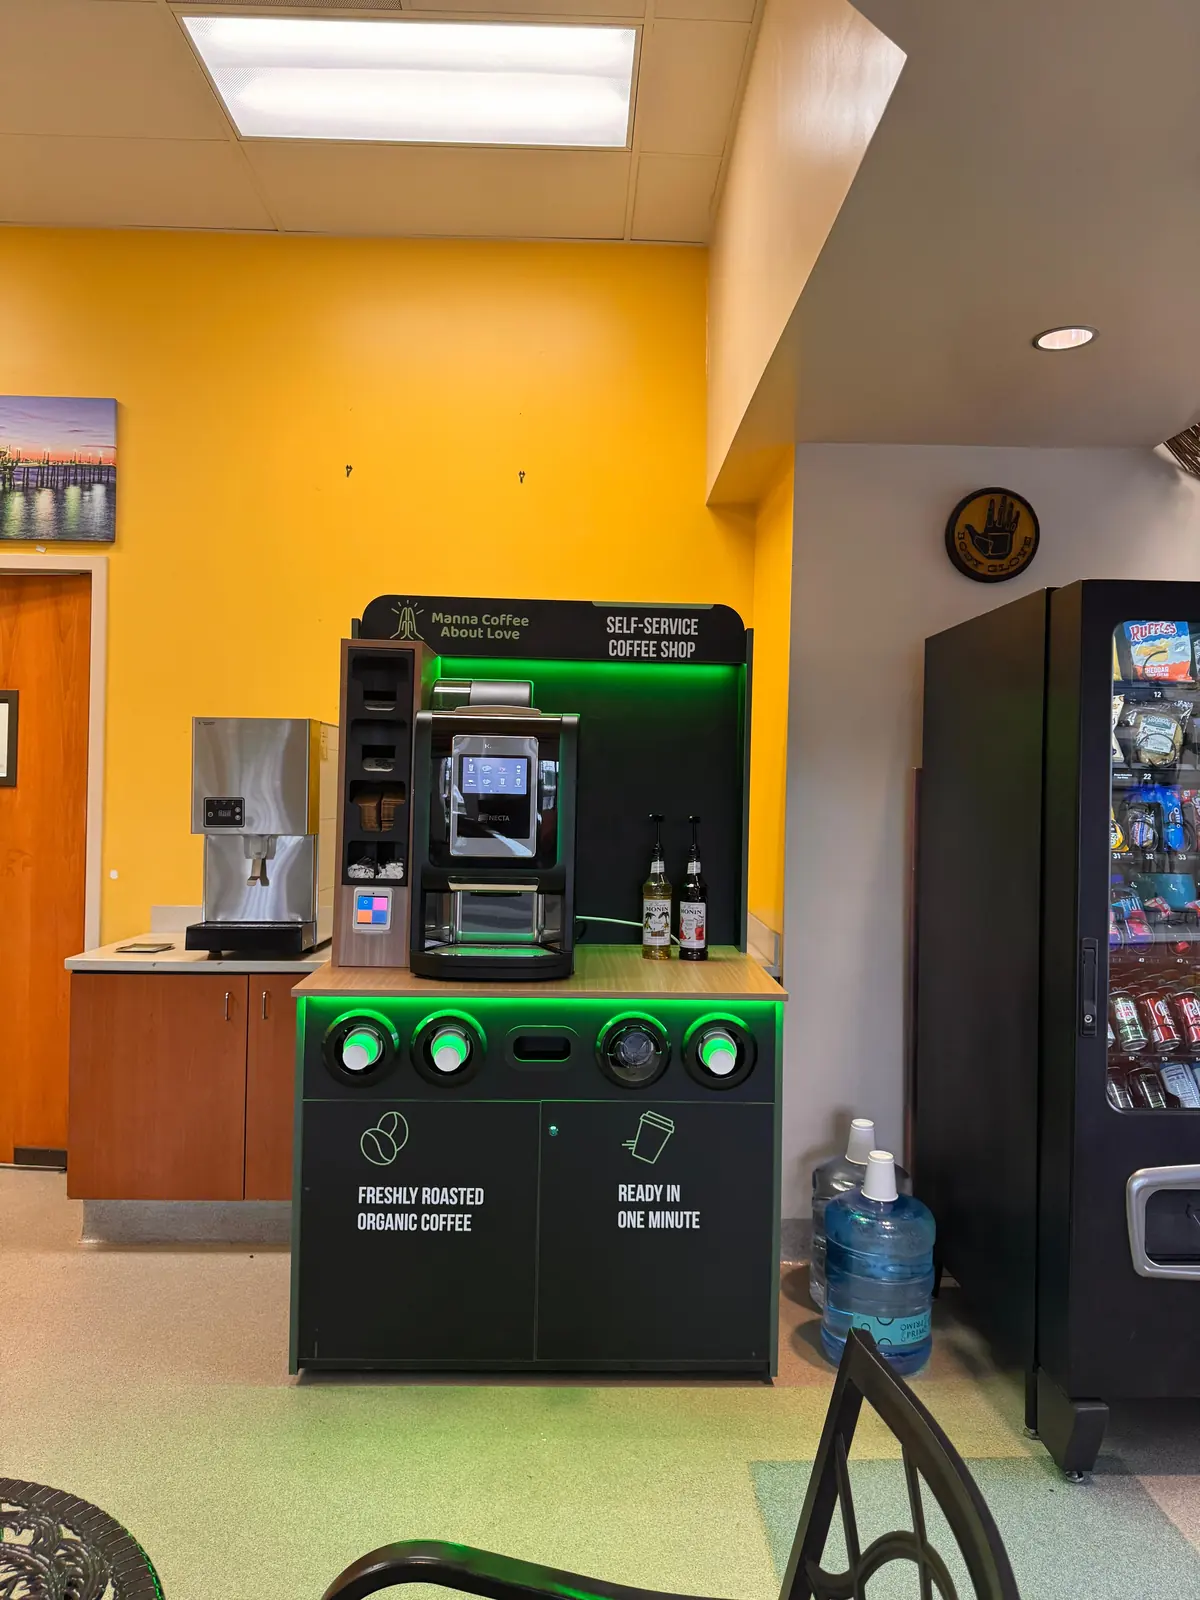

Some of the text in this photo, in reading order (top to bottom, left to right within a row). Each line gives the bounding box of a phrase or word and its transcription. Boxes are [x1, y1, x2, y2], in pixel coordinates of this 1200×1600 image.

[431, 612, 529, 627] Manna Coffee
[606, 616, 699, 636] SELF-SERVICE
[440, 626, 520, 640] About Love
[1130, 621, 1177, 641] RUFFLES
[608, 639, 696, 658] COFFEE SHOP
[357, 1186, 485, 1206] FRESHLY ROASTED
[618, 1184, 681, 1203] READY IN
[357, 1212, 473, 1232] ORGANIC COFFEE
[617, 1210, 701, 1229] ONE MINUTE
